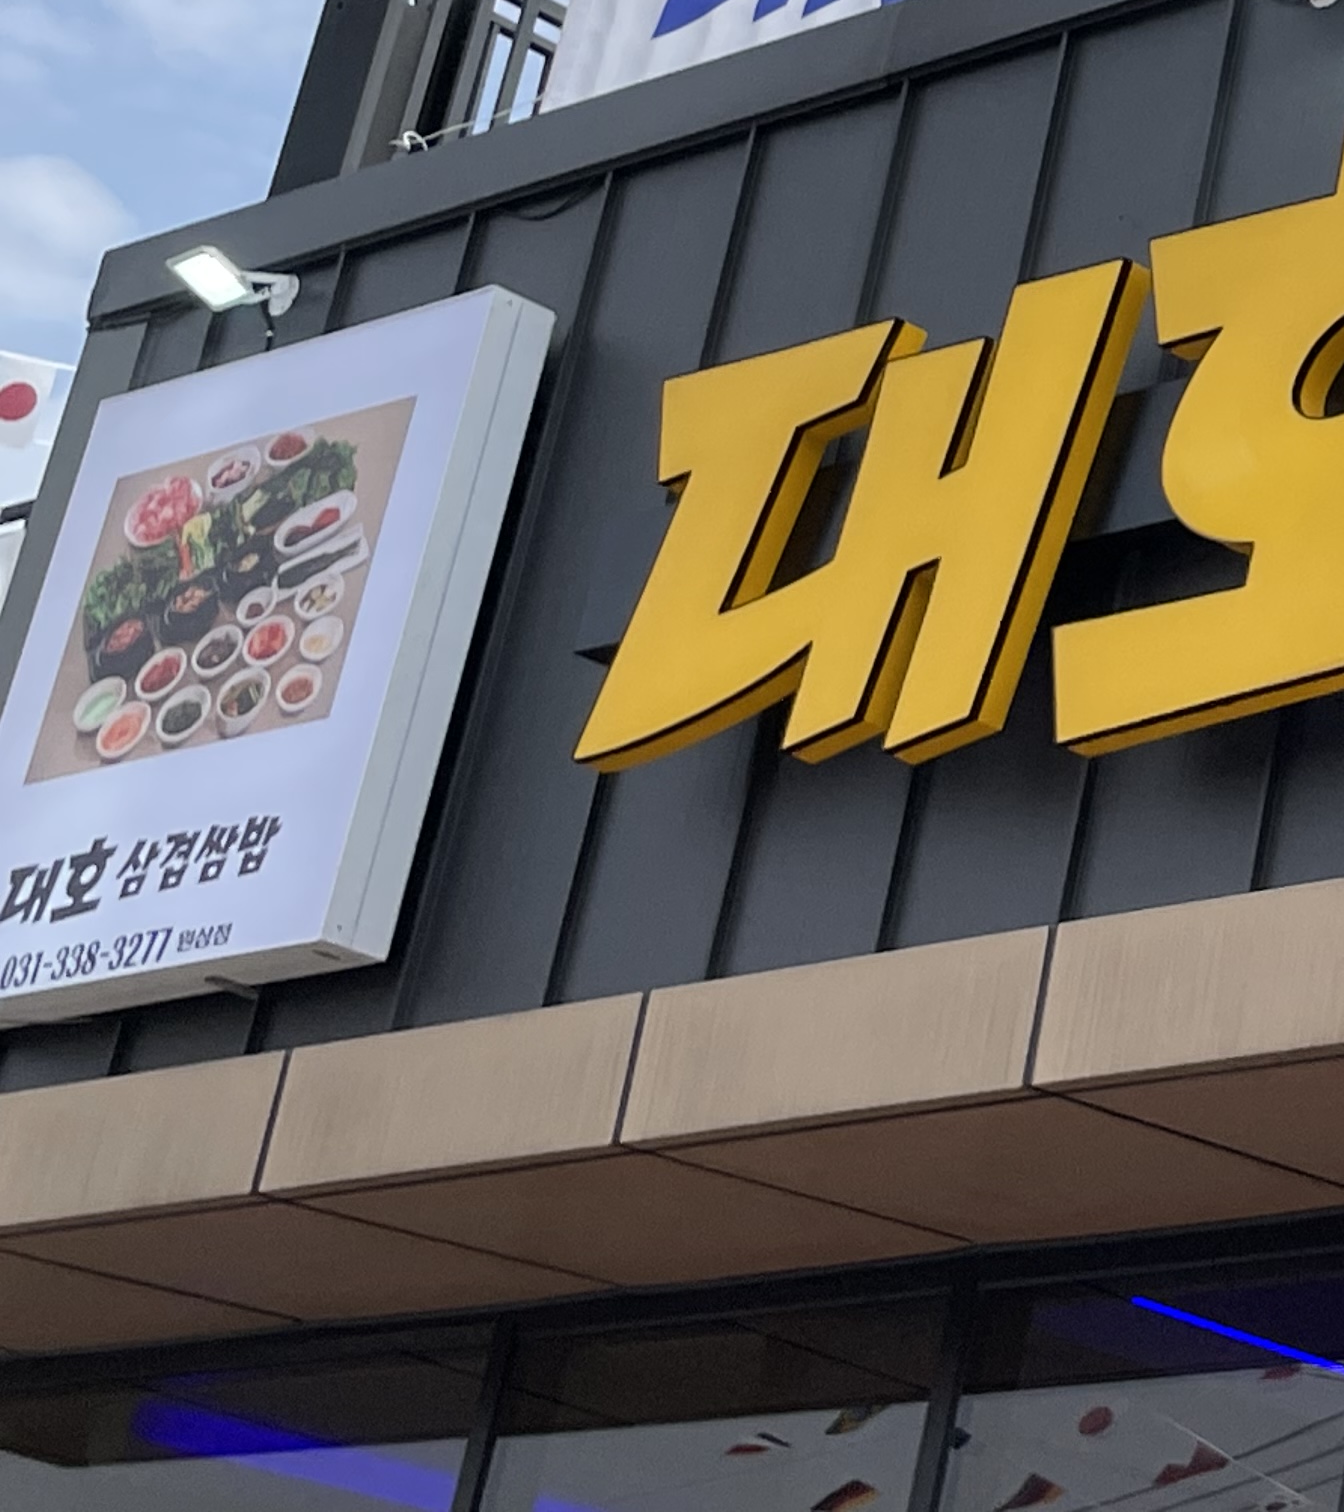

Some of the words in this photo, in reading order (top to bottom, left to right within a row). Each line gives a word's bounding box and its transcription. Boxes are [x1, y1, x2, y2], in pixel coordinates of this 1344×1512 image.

[0, 835, 117, 924] 대호
[116, 815, 282, 899] 삼겹쌈밥
[1, 927, 173, 988] 031-338-3277
